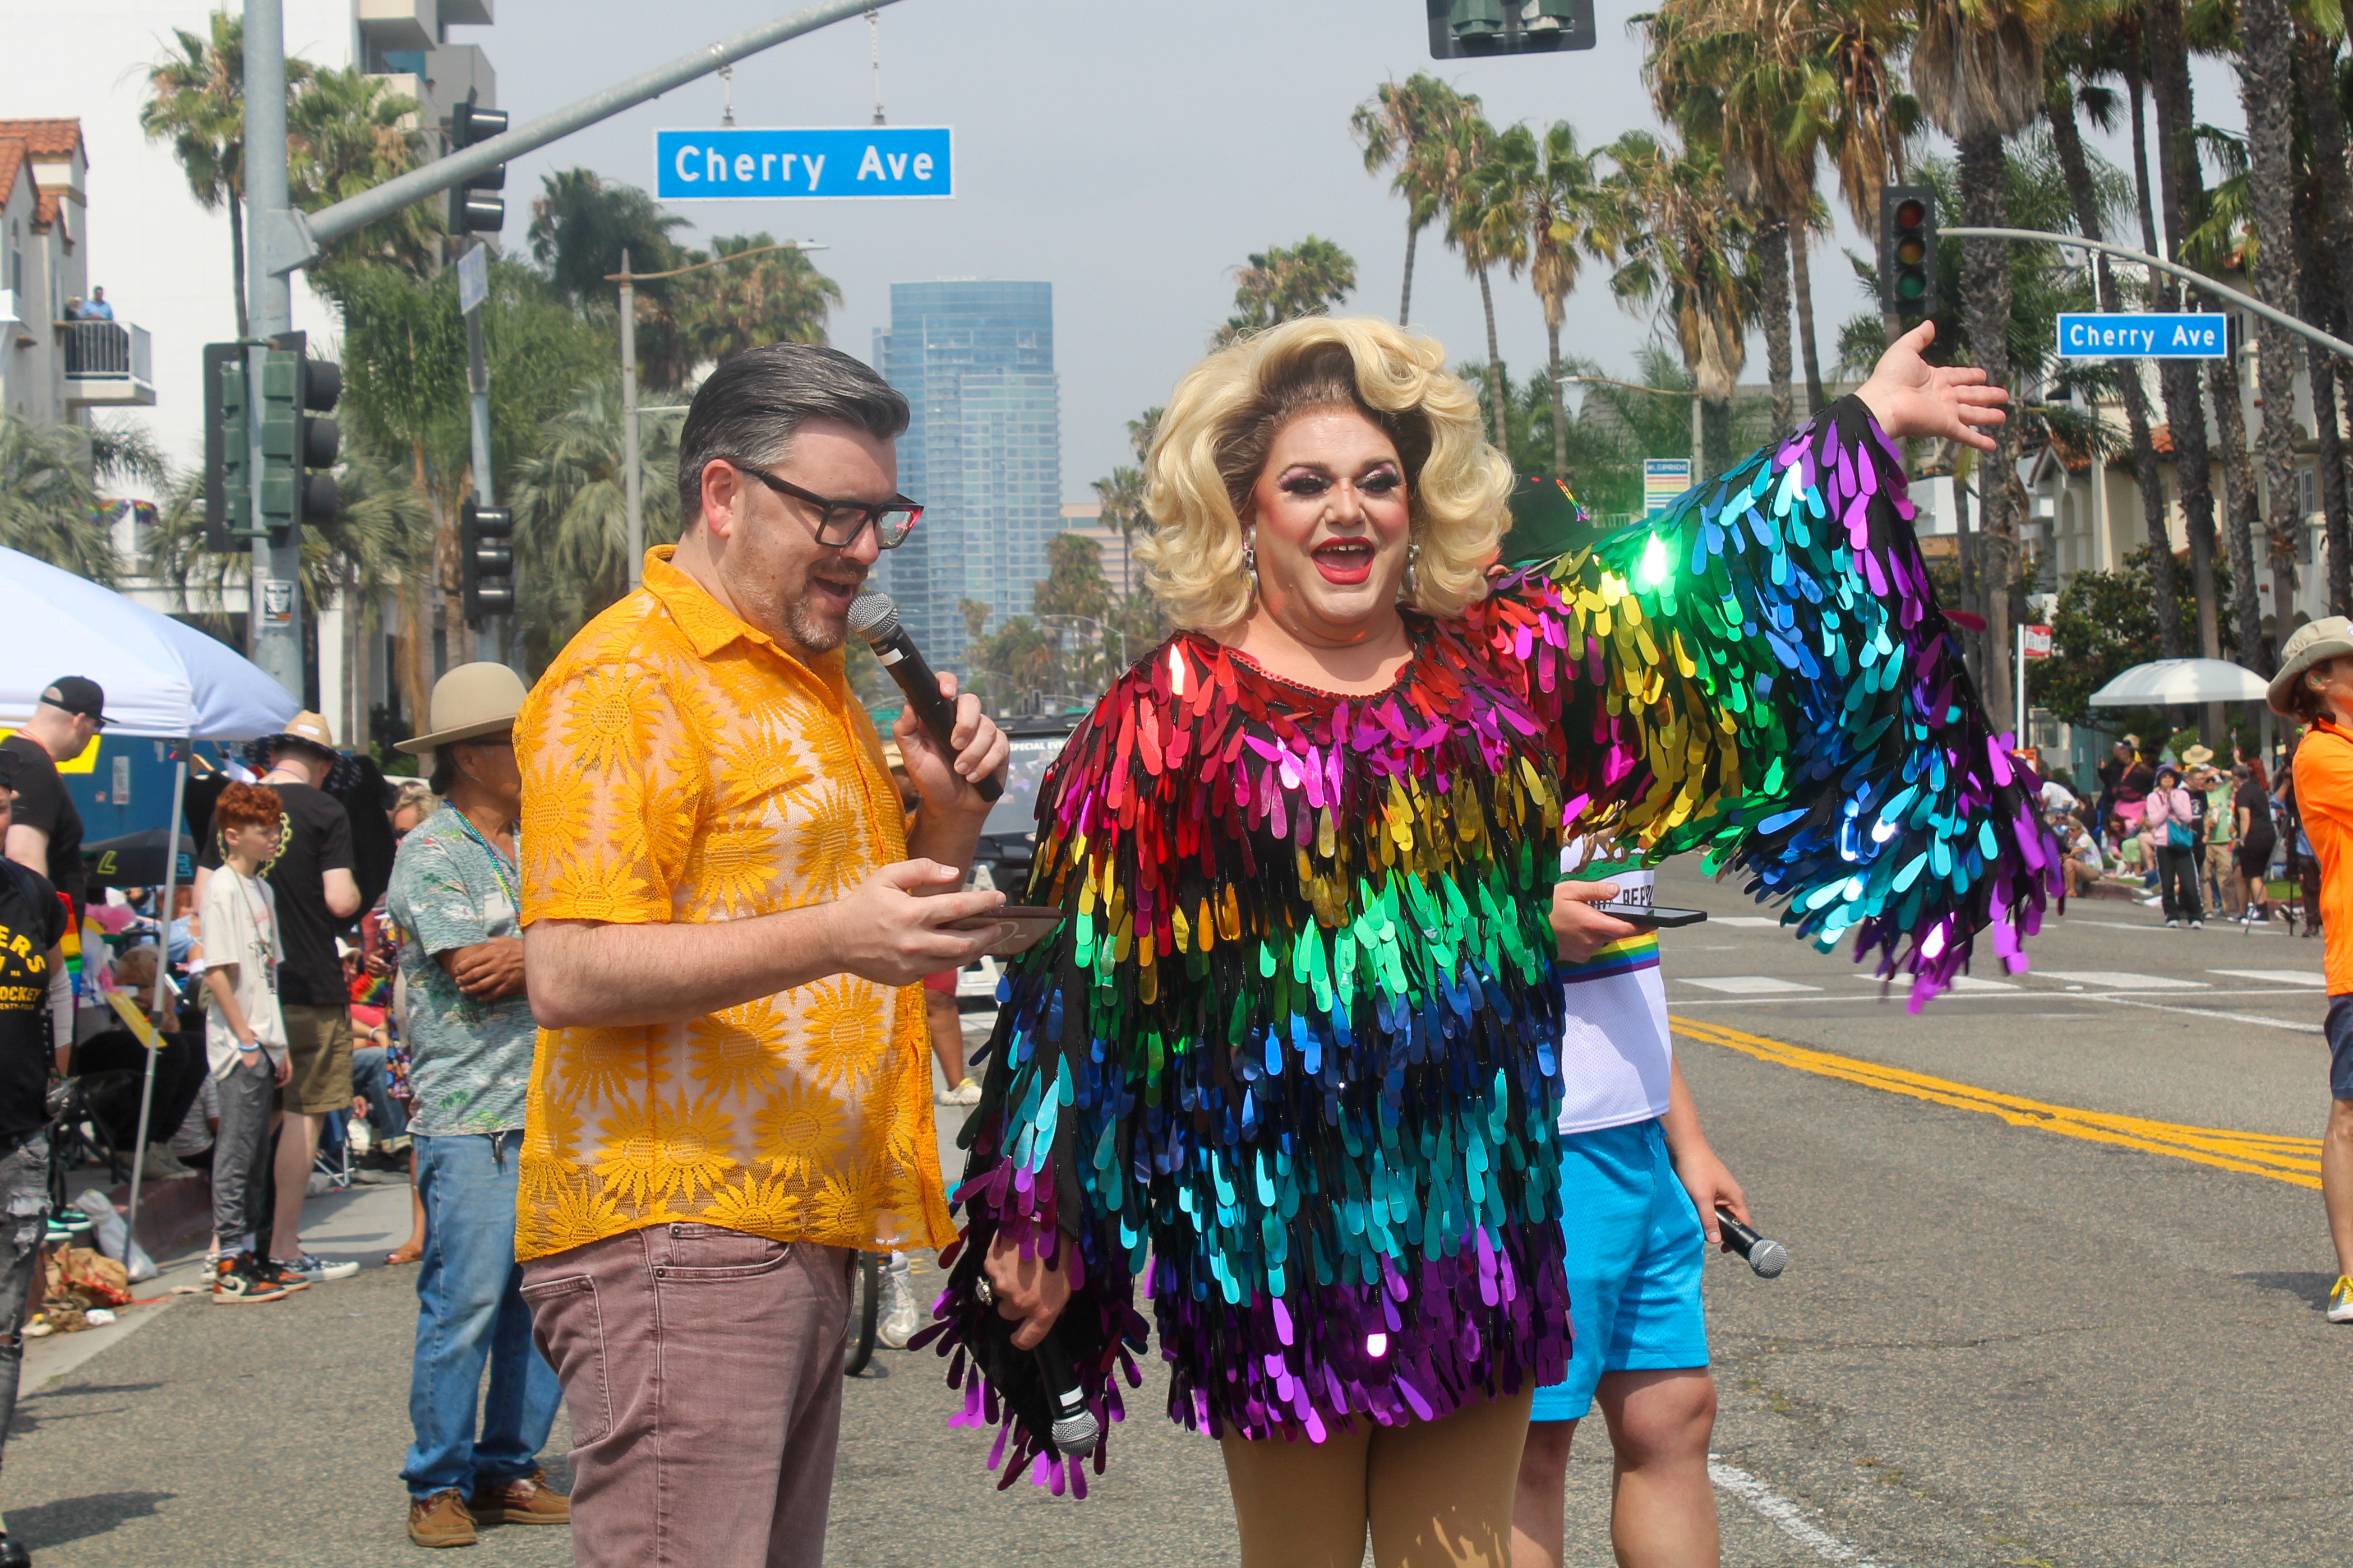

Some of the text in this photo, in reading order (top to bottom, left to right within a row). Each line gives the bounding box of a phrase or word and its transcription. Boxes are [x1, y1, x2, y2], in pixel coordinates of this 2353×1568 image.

[675, 145, 934, 191] Cherry Ave
[2070, 323, 2215, 352] Cherry Ave
